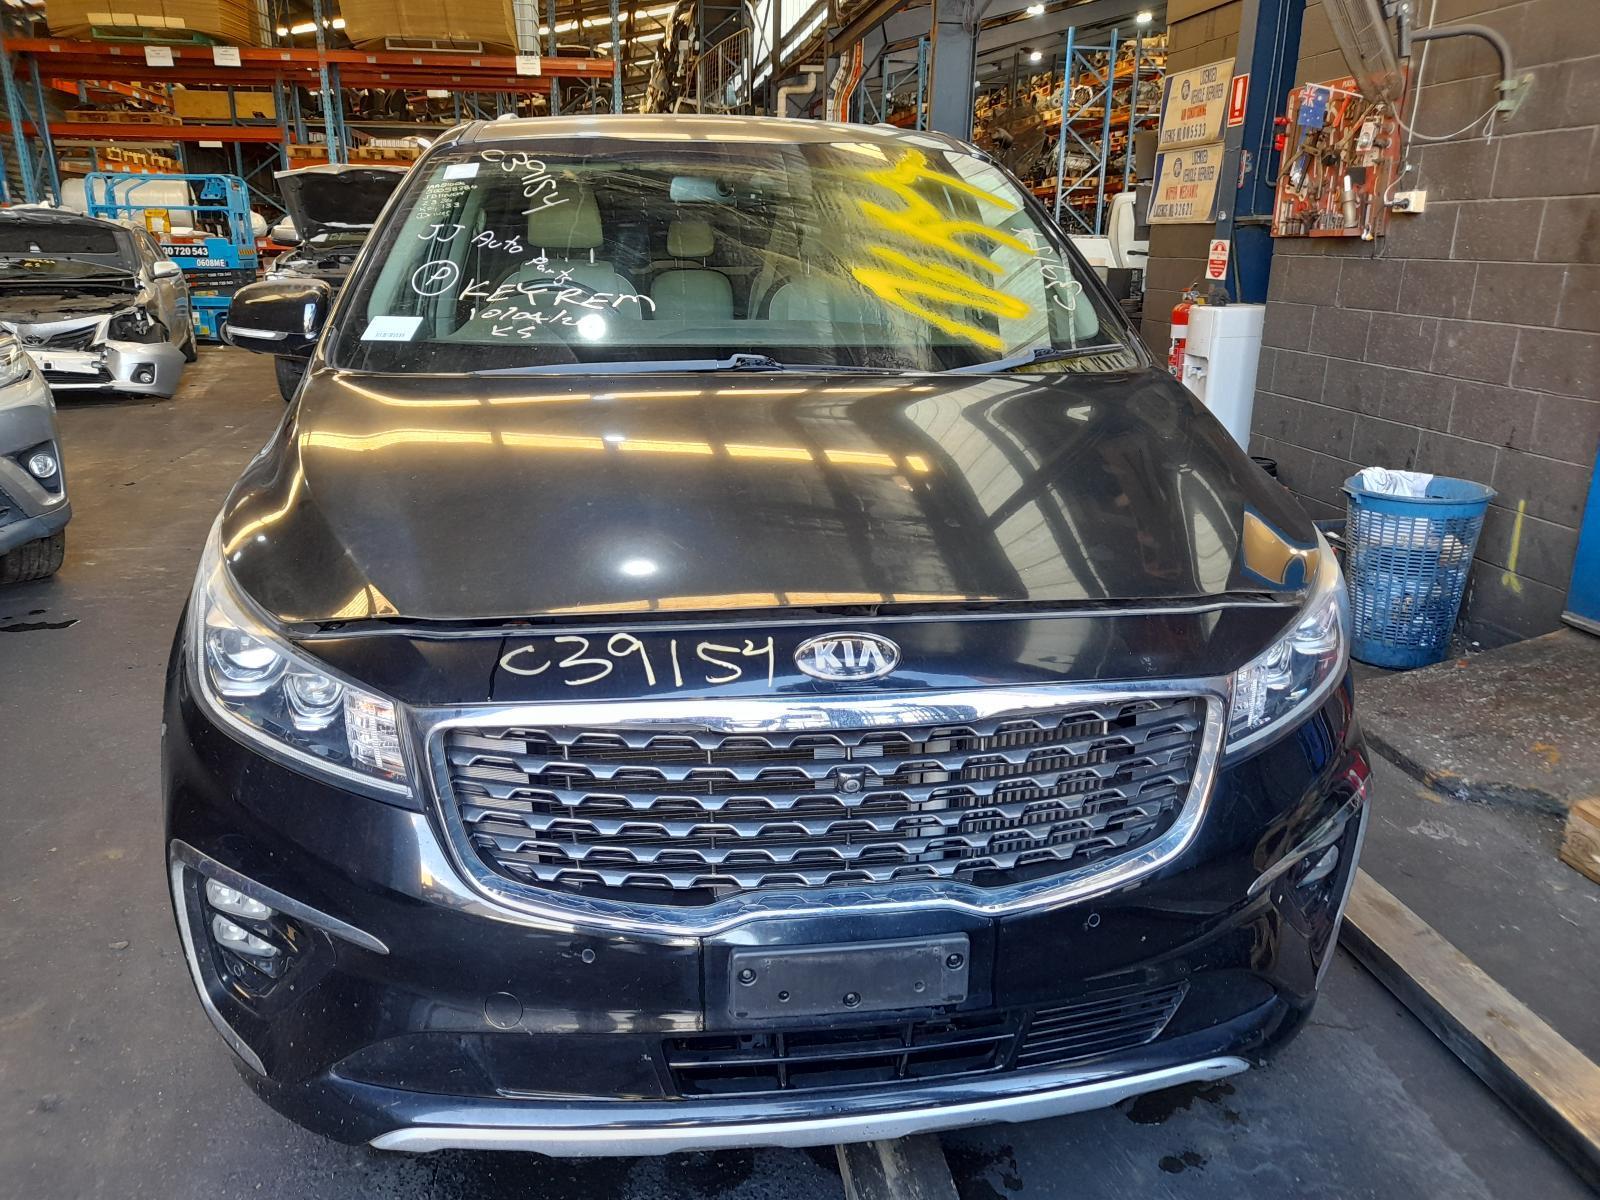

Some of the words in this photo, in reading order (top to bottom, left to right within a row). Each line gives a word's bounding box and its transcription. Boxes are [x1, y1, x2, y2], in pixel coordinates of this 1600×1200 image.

[481, 149, 570, 215] C39154
[174, 246, 191, 255] 720
[192, 247, 209, 256] 543
[499, 632, 776, 688] C39154
[814, 640, 888, 669] KIA
